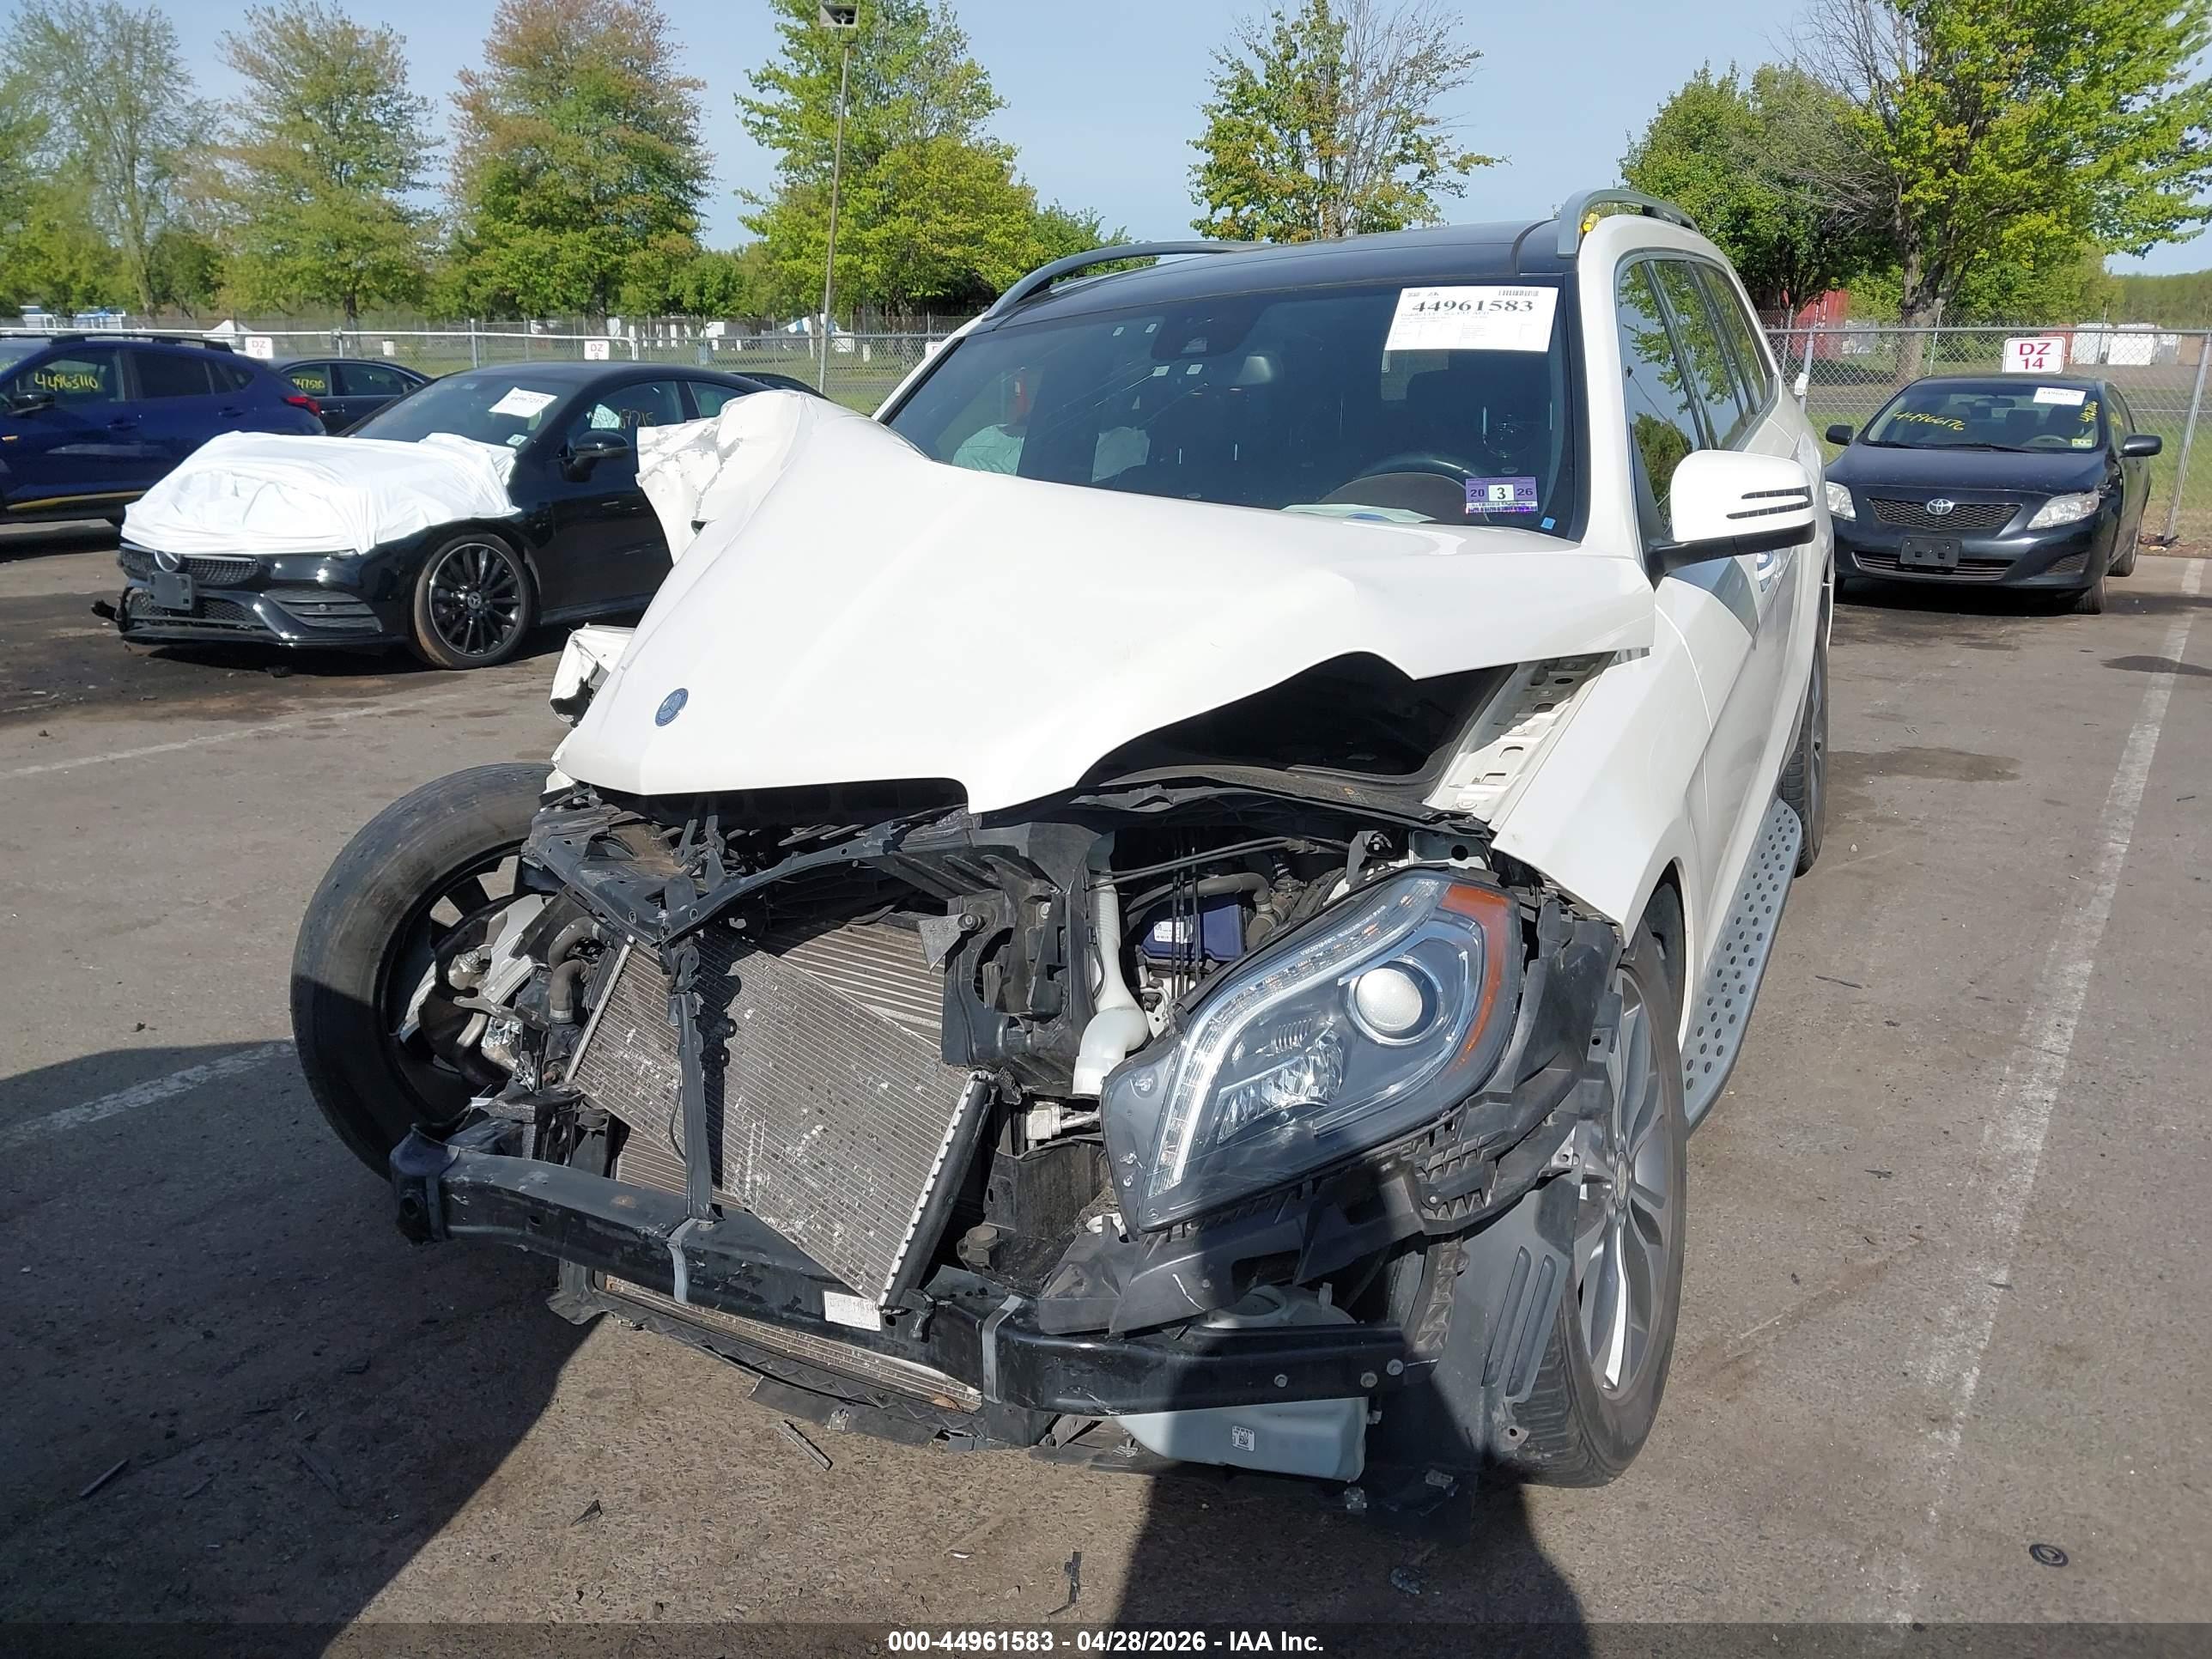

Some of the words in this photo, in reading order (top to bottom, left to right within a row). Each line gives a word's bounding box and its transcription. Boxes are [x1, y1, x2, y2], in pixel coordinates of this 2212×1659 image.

[1412, 300, 1534, 313] 44961583
[252, 340, 266, 349] DZ
[590, 343, 604, 352] DZ
[2019, 342, 2051, 356] DZ
[2021, 357, 2045, 369] 14
[1893, 410, 1966, 431] 44966176
[1470, 489, 1486, 497] 20
[1497, 487, 1506, 499] 3
